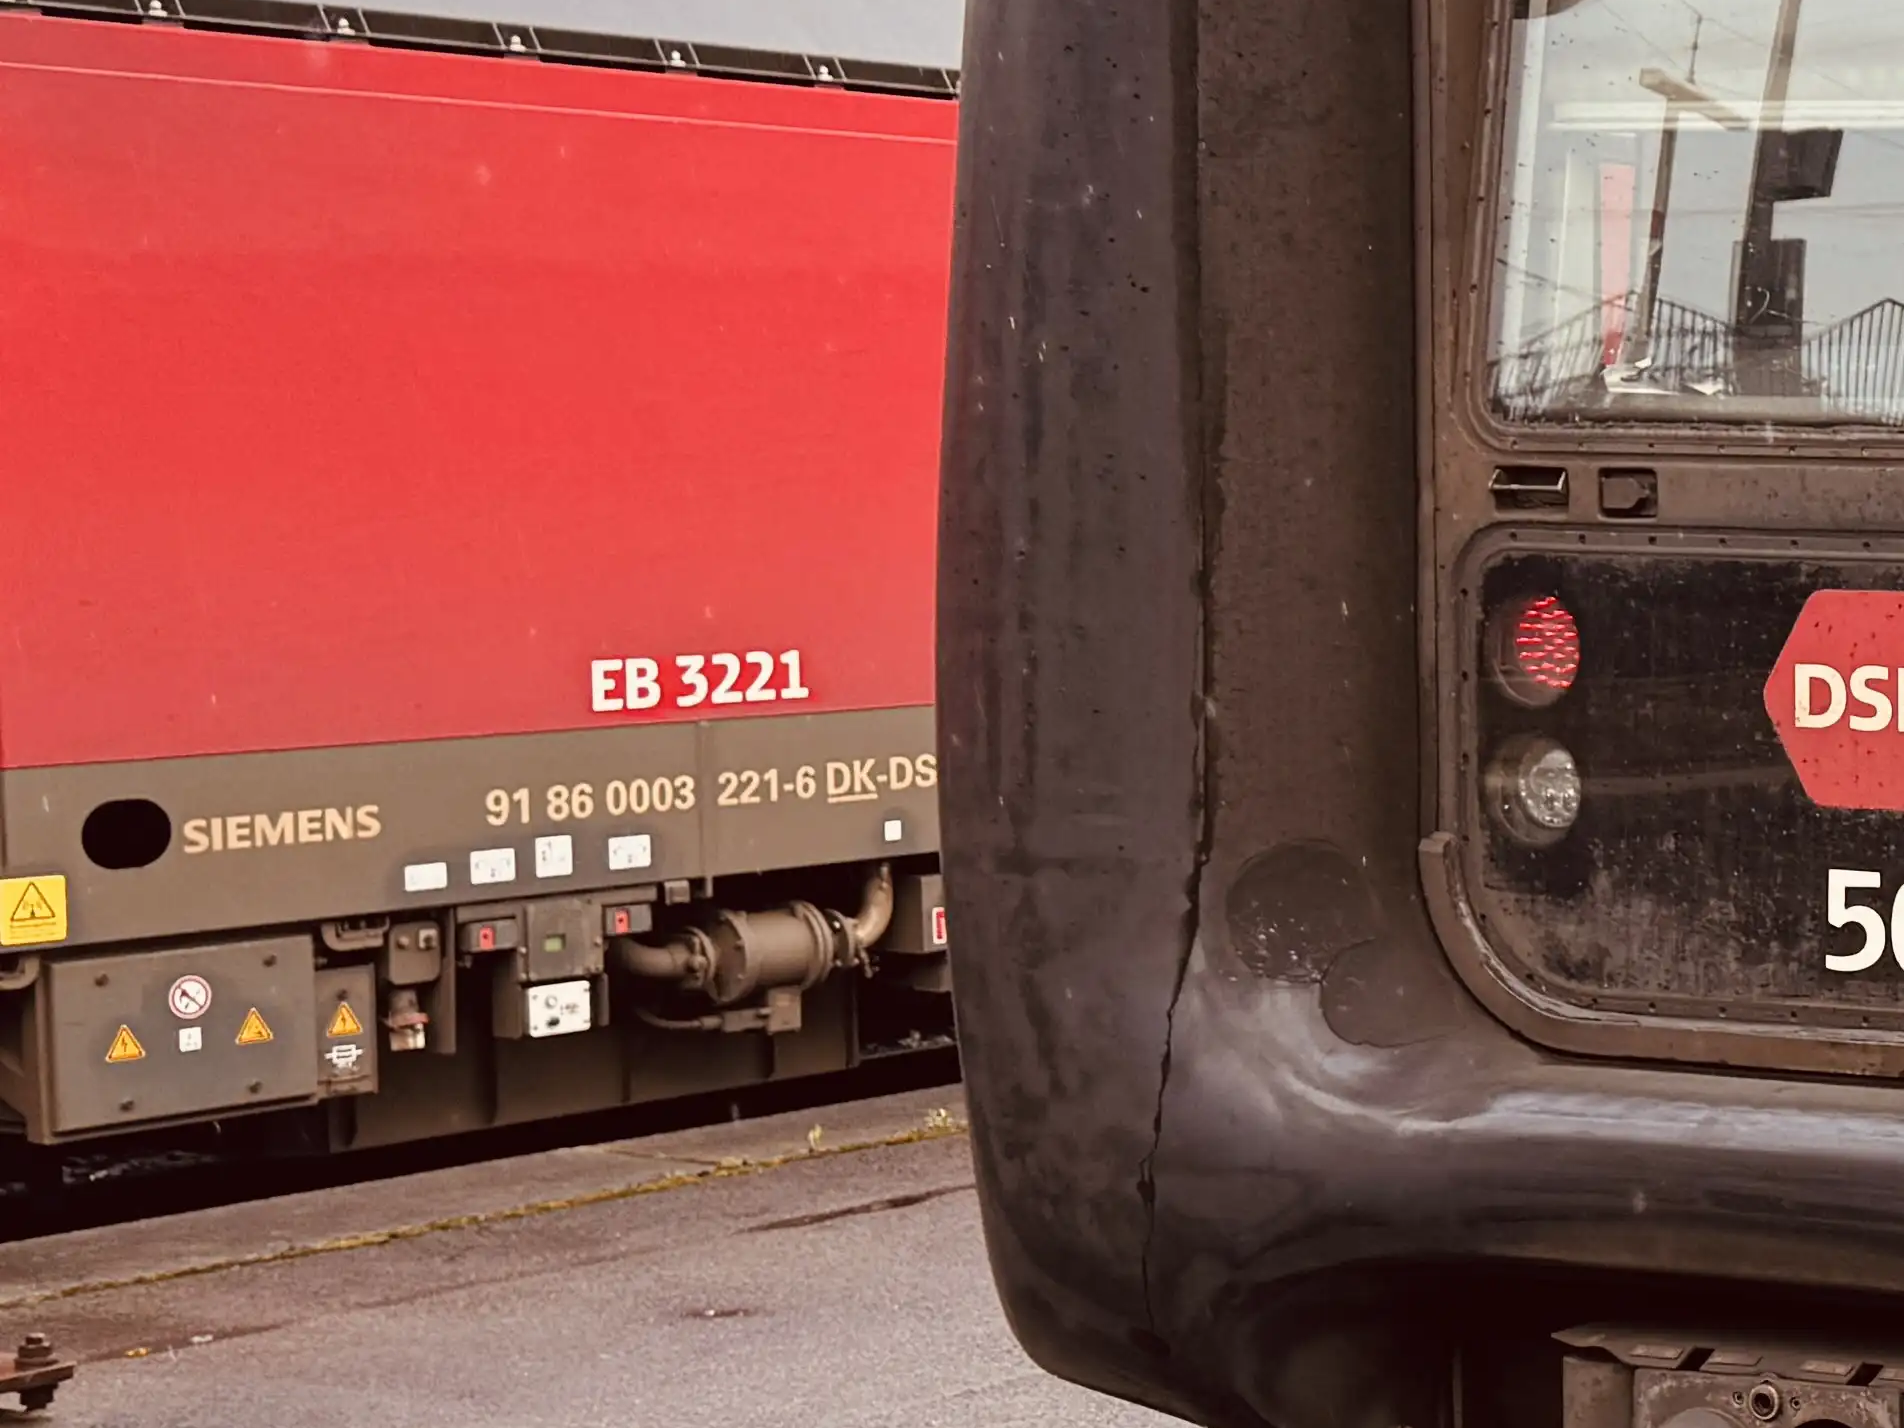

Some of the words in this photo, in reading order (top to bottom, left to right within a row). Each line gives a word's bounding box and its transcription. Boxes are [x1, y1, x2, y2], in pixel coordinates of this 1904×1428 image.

[591, 657, 661, 712] EB
[675, 649, 810, 708] 3221
[485, 787, 531, 826] 91
[546, 782, 594, 821] 86
[606, 775, 696, 816] 0003
[717, 765, 816, 807] 221-6
[183, 804, 381, 854] SIEMENS
